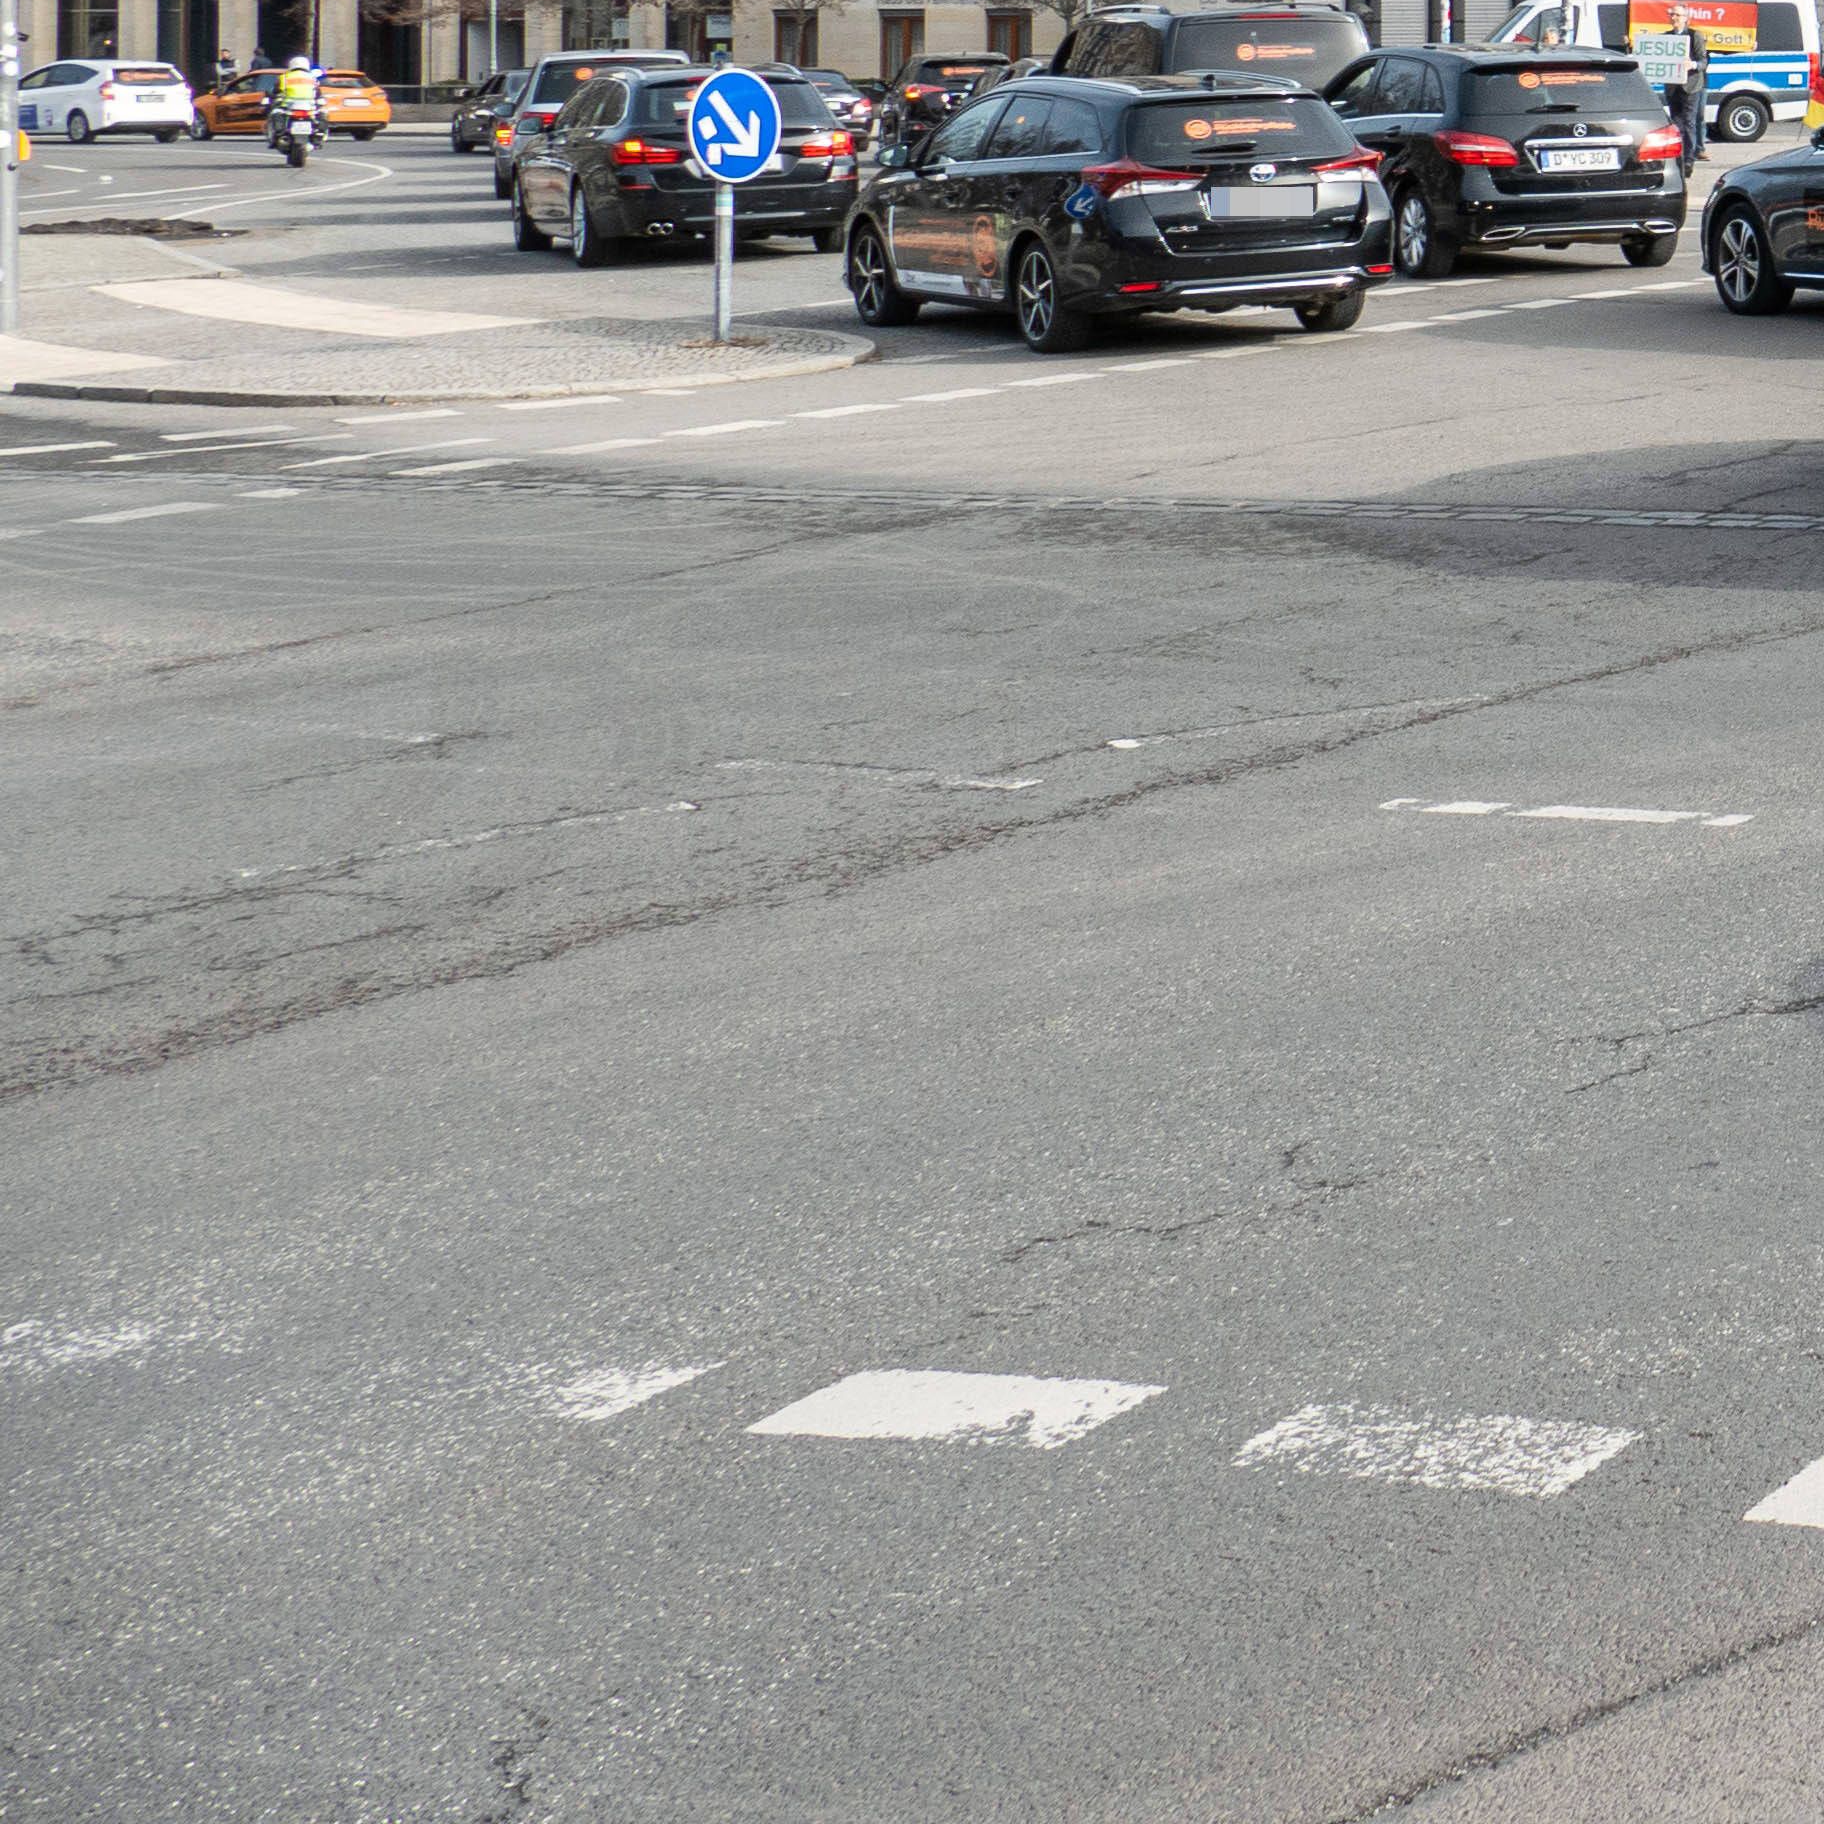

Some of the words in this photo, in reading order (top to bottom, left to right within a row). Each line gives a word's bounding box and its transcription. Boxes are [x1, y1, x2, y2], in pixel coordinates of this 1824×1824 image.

[1715, 8, 1725, 21] ?
[1713, 33, 1743, 45] Gott
[1635, 41, 1686, 57] JESUS
[1644, 62, 1682, 78] EBT!
